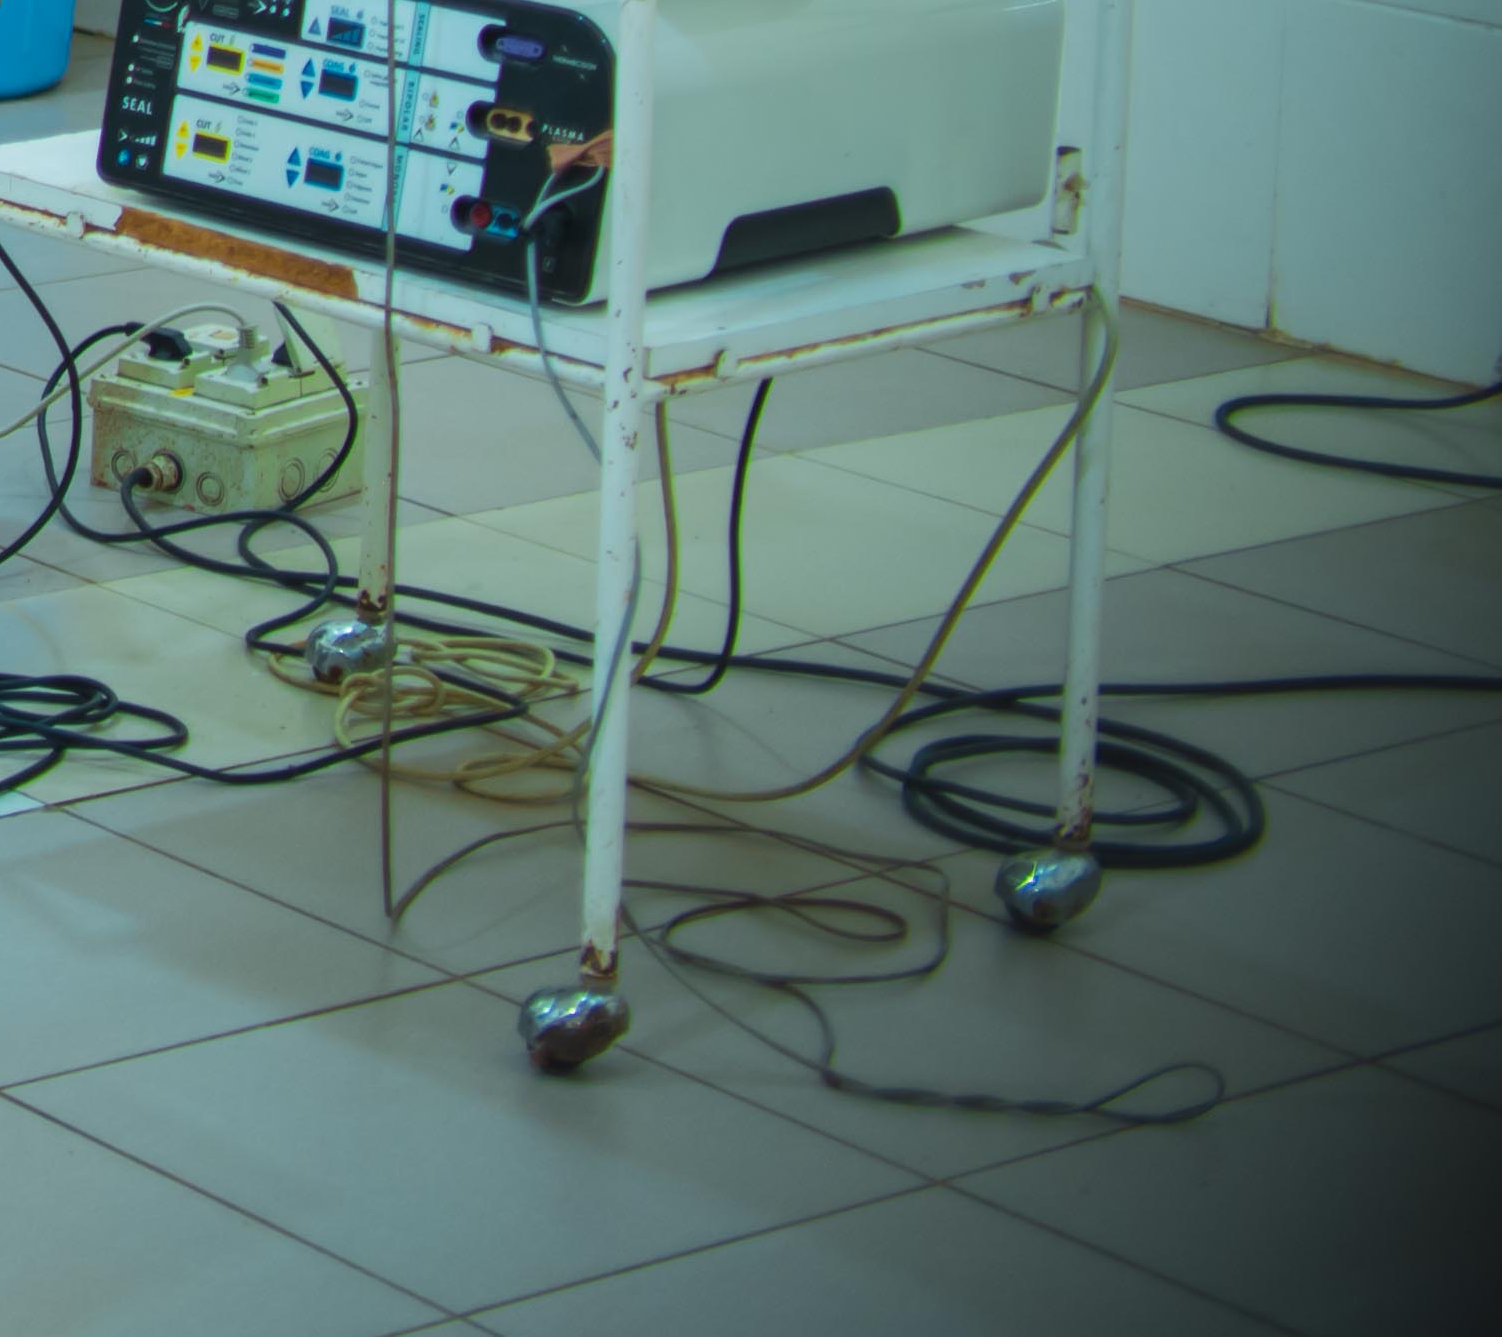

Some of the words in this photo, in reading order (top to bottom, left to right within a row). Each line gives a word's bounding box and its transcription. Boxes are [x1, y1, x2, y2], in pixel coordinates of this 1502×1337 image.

[209, 32, 225, 43] CUT
[121, 95, 153, 115] SEAL
[196, 118, 212, 130] CUT
[541, 123, 584, 142] PLASMA
